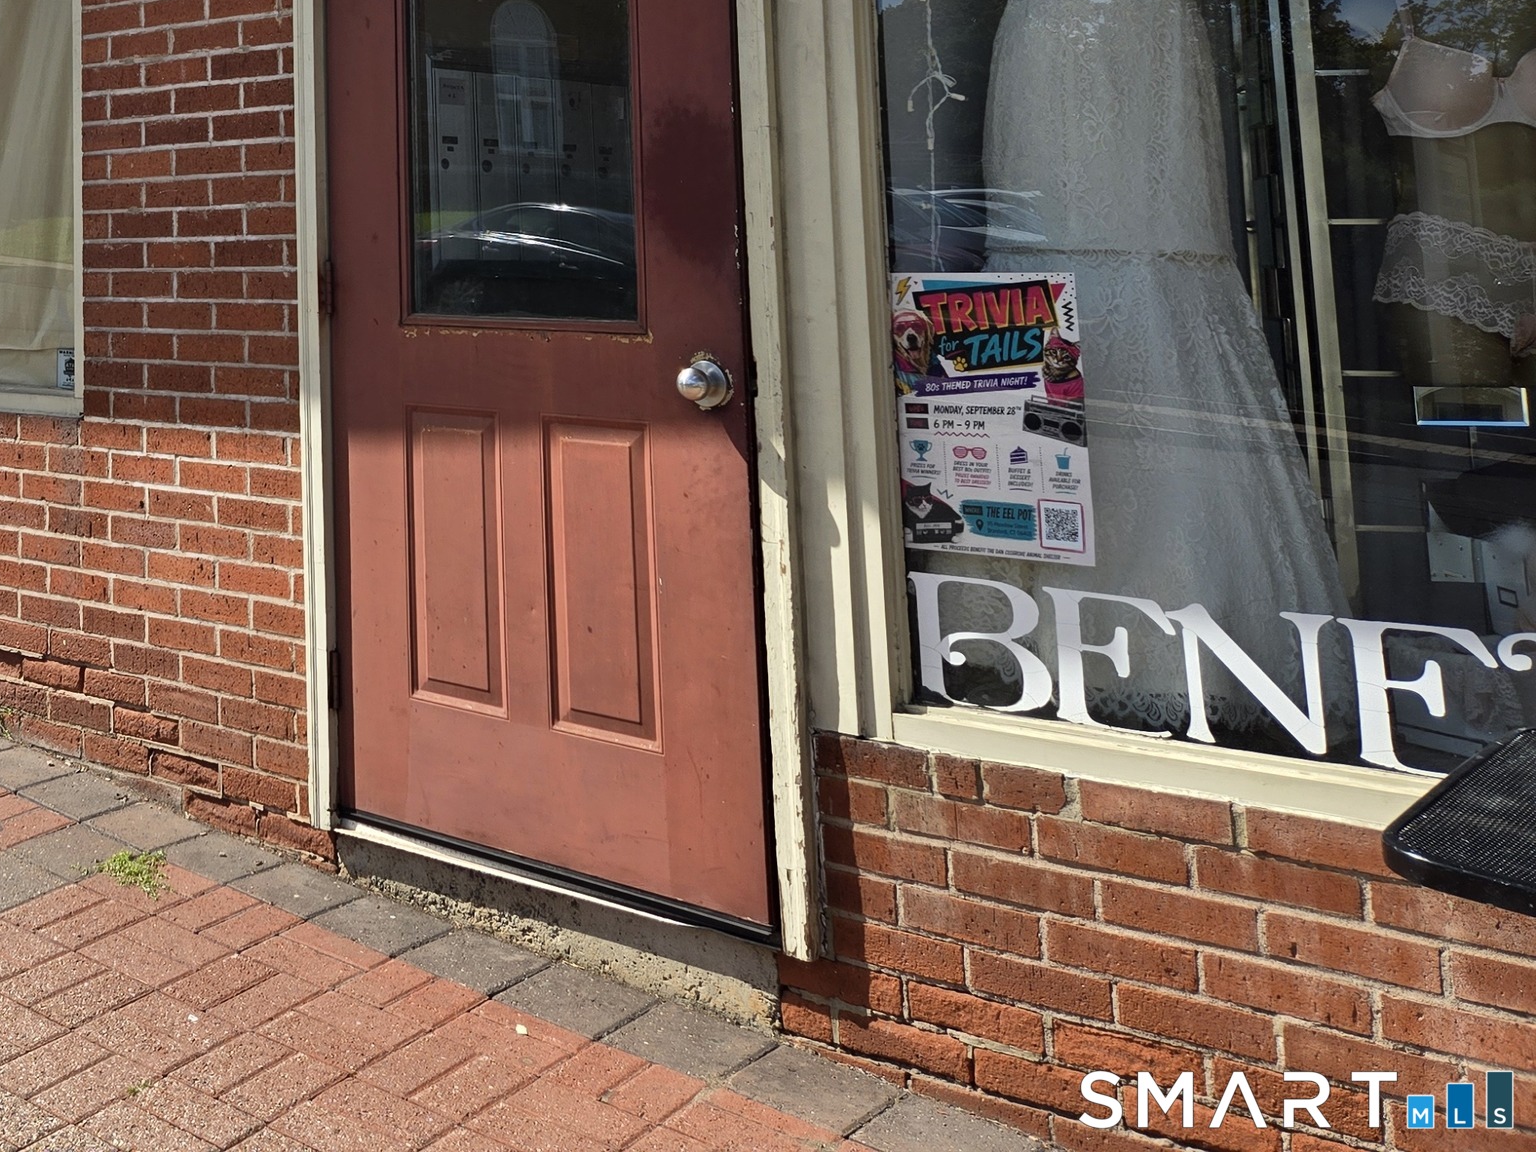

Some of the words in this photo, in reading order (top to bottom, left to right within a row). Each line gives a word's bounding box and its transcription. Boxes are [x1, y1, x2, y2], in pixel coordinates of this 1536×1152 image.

[920, 285, 1054, 335] TRIVIA
[938, 335, 959, 356] for
[963, 328, 1042, 366] TAILS
[925, 383, 939, 392] 80s
[941, 380, 971, 391] THEMED
[973, 379, 998, 388] TRIVIA
[1000, 376, 1028, 386] NIGHT!
[933, 405, 963, 416] MONDAY,
[965, 406, 1004, 415] SEPTEMBER
[933, 419, 940, 428] 6
[942, 420, 954, 428] PM
[964, 420, 970, 430] 9
[973, 421, 985, 430] PM
[986, 506, 1000, 518] THE
[1003, 507, 1015, 519] EEL
[1017, 508, 1032, 521] POT
[907, 570, 1536, 779] BENE
